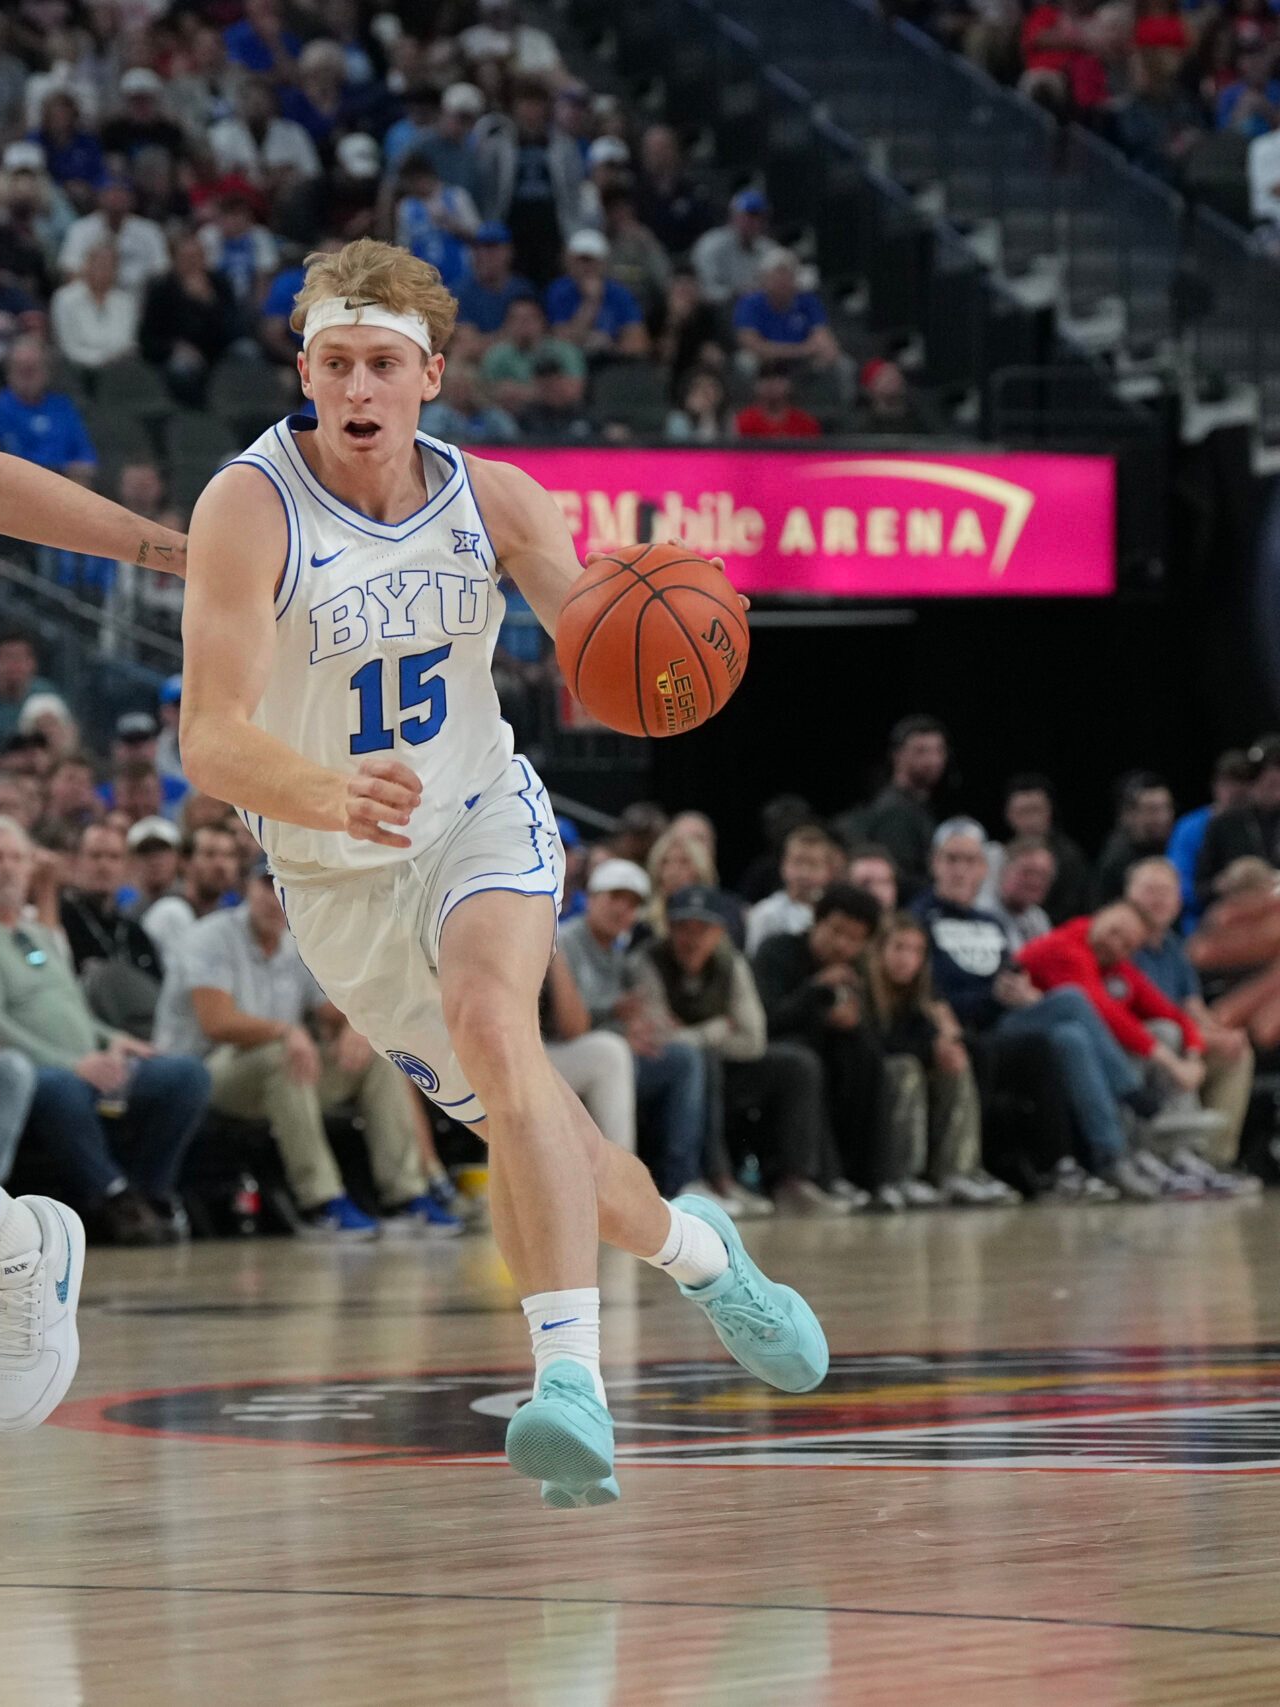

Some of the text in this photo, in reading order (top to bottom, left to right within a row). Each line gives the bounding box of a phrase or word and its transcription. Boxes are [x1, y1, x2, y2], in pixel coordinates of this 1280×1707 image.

[778, 506, 987, 557] ARENA
[309, 570, 491, 665] BYU
[349, 642, 453, 755] 15
[4, 1262, 28, 1275] BOOK
